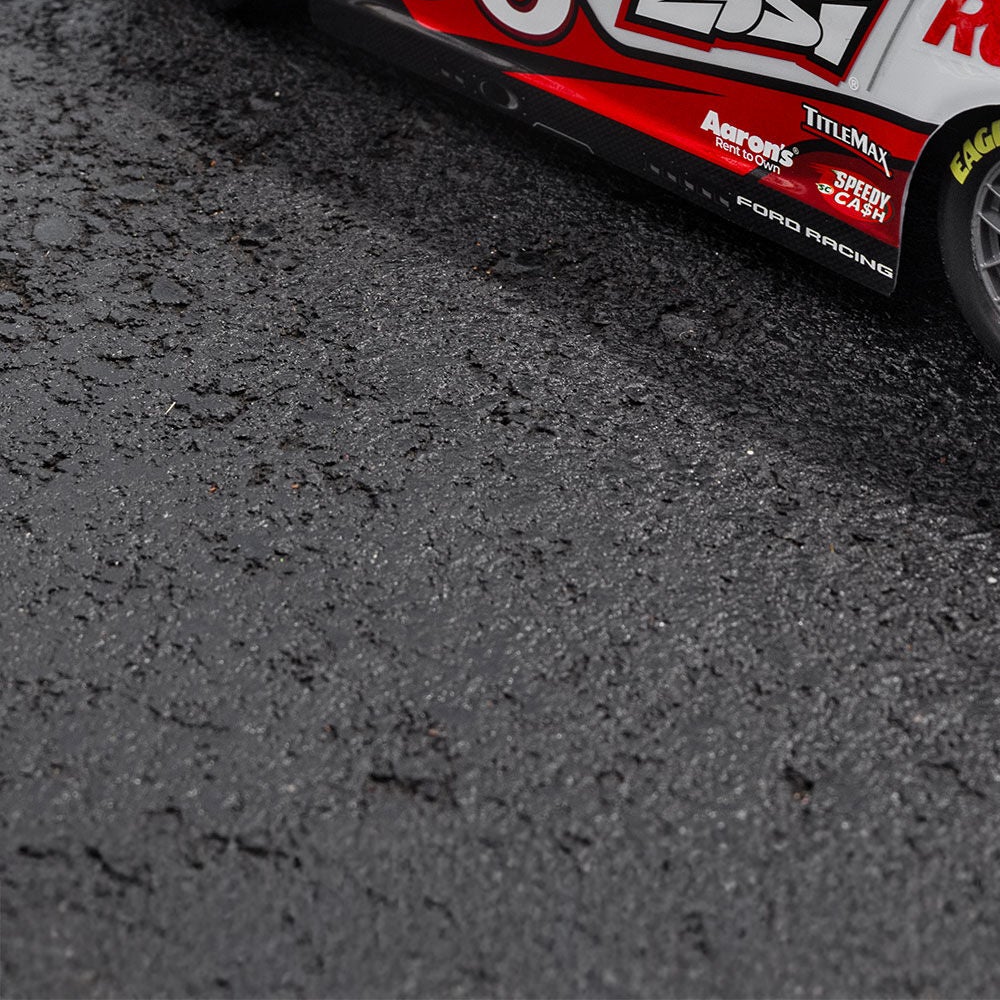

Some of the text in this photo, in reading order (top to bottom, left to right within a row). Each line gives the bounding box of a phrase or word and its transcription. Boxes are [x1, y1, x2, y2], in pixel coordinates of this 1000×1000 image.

[715, 136, 781, 175] Rent to Own
[833, 170, 892, 210] SPEEDY
[736, 195, 894, 279] FORD RACING
